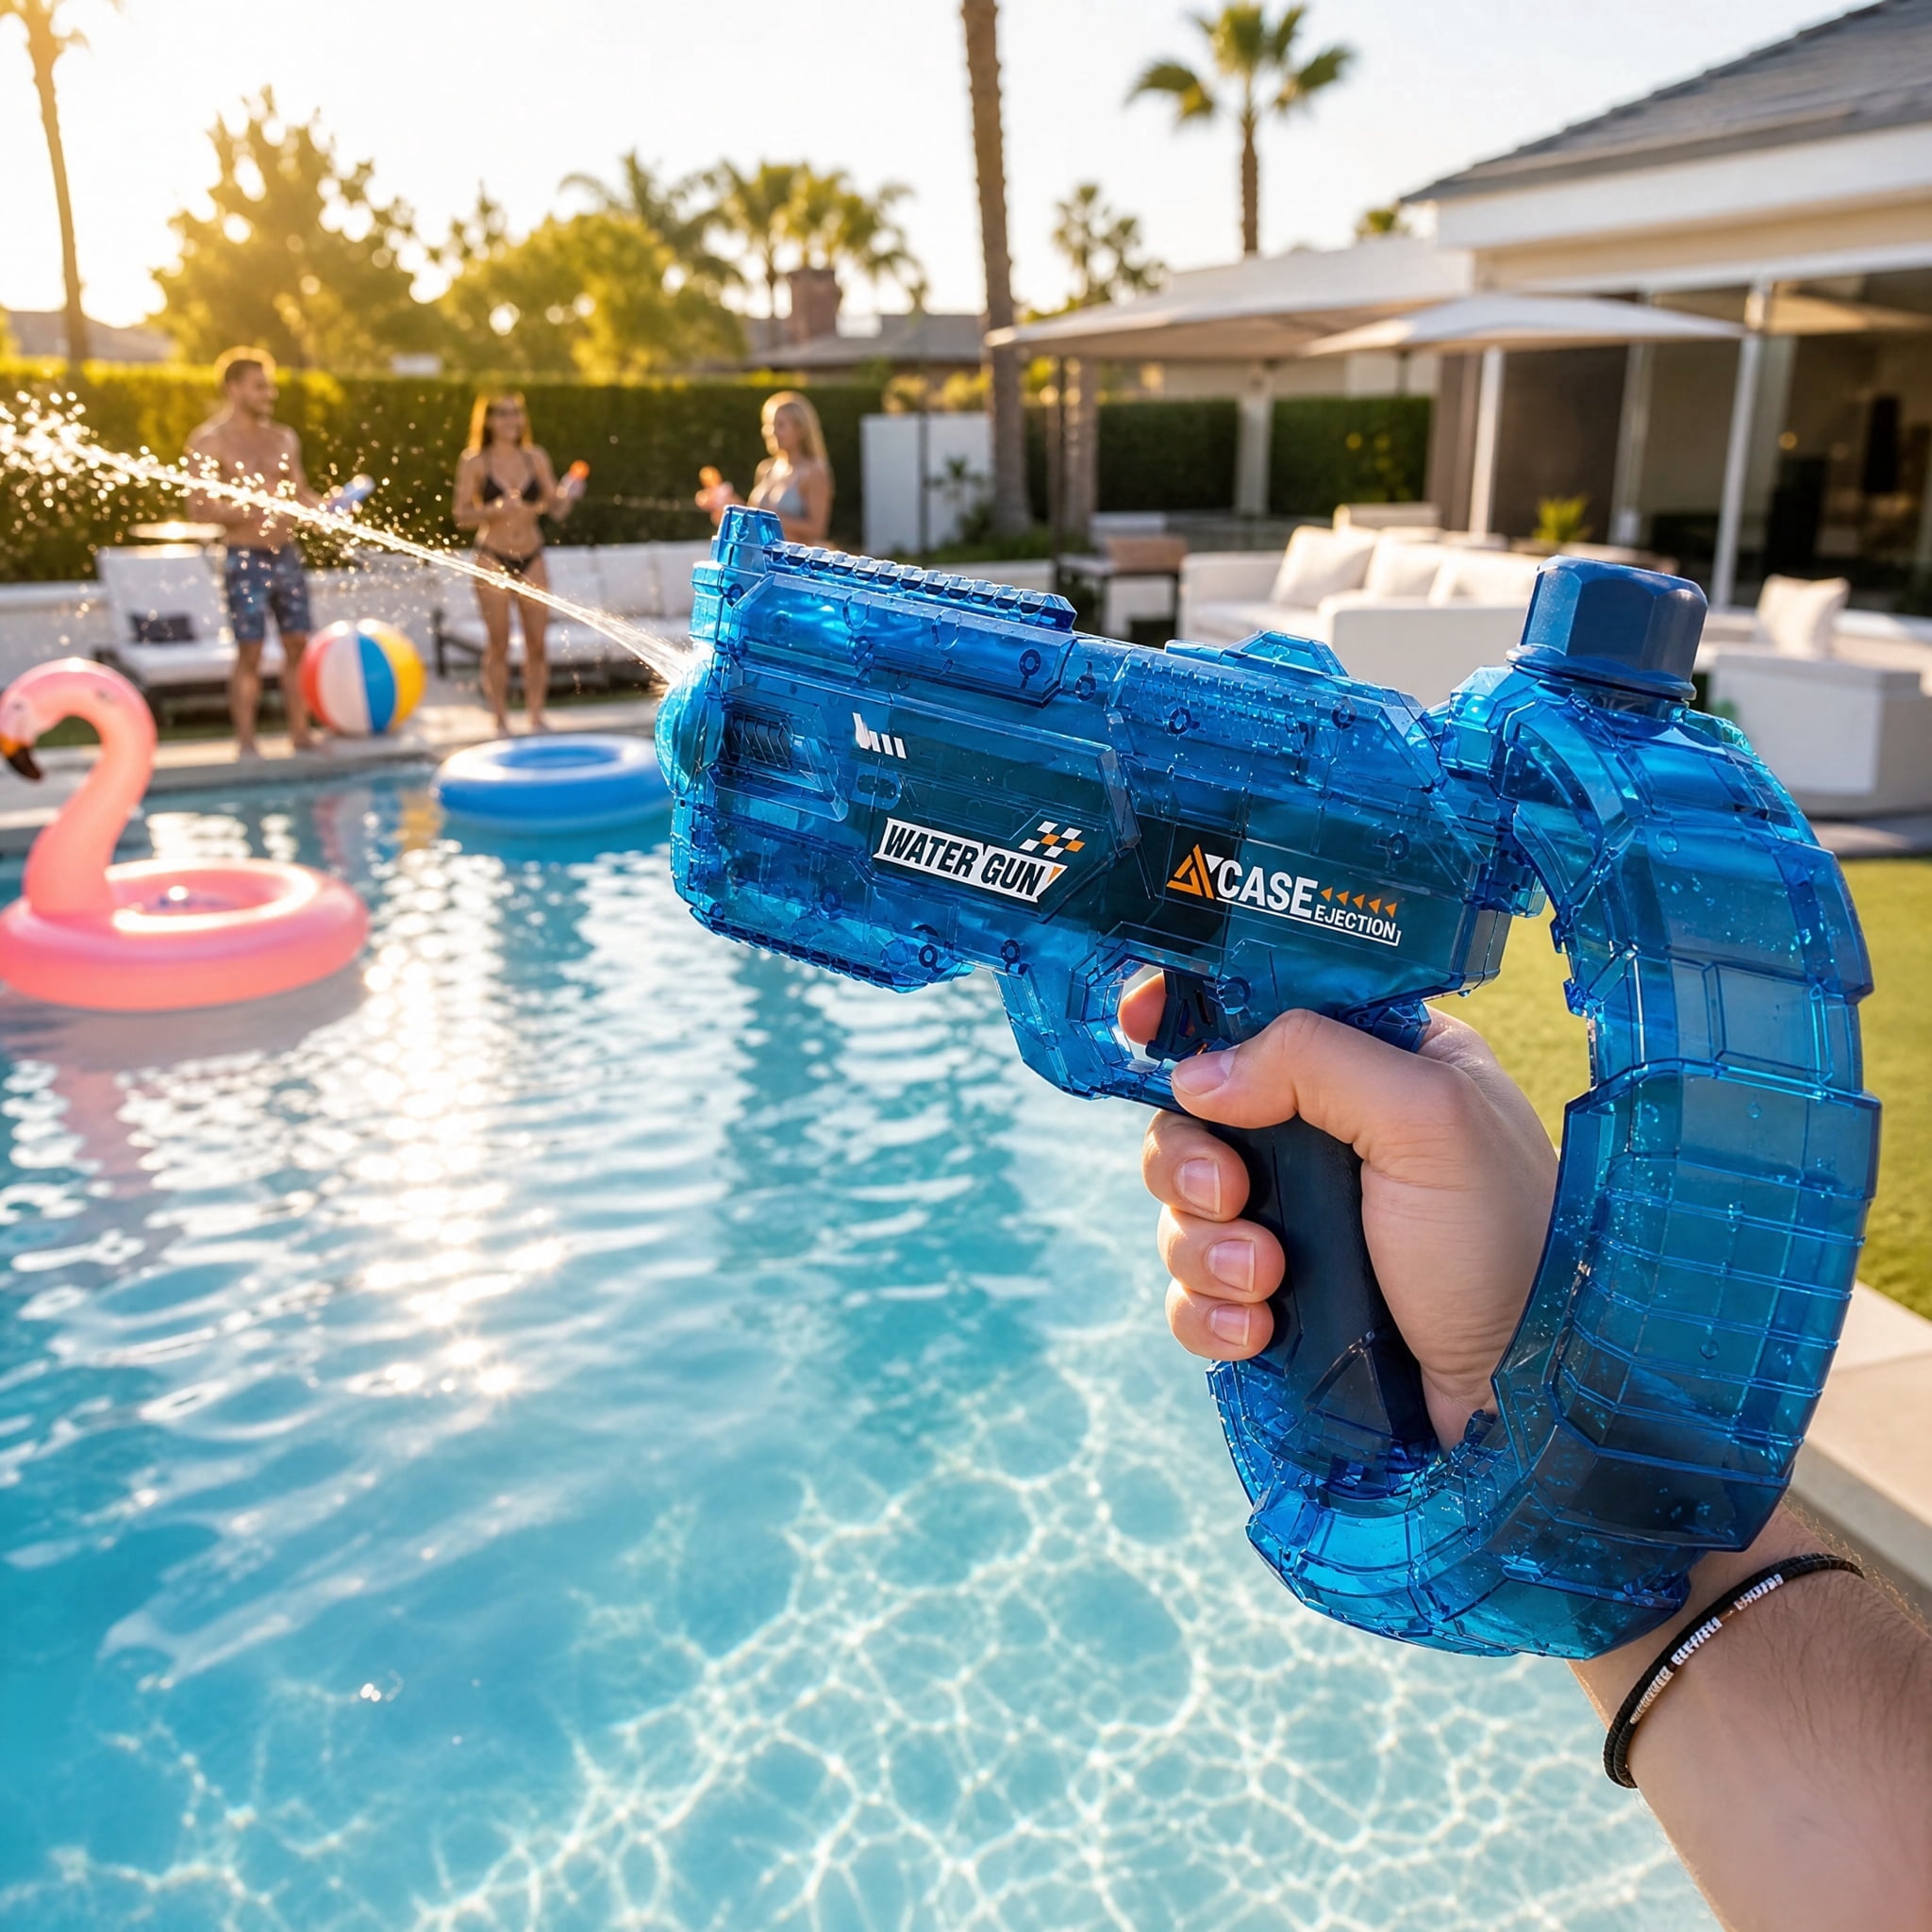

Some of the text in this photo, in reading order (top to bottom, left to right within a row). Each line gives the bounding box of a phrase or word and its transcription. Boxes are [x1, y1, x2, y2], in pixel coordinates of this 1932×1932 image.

[883, 824, 1046, 896] WATER GUN
[1217, 859, 1396, 940] CASE EJECTION
